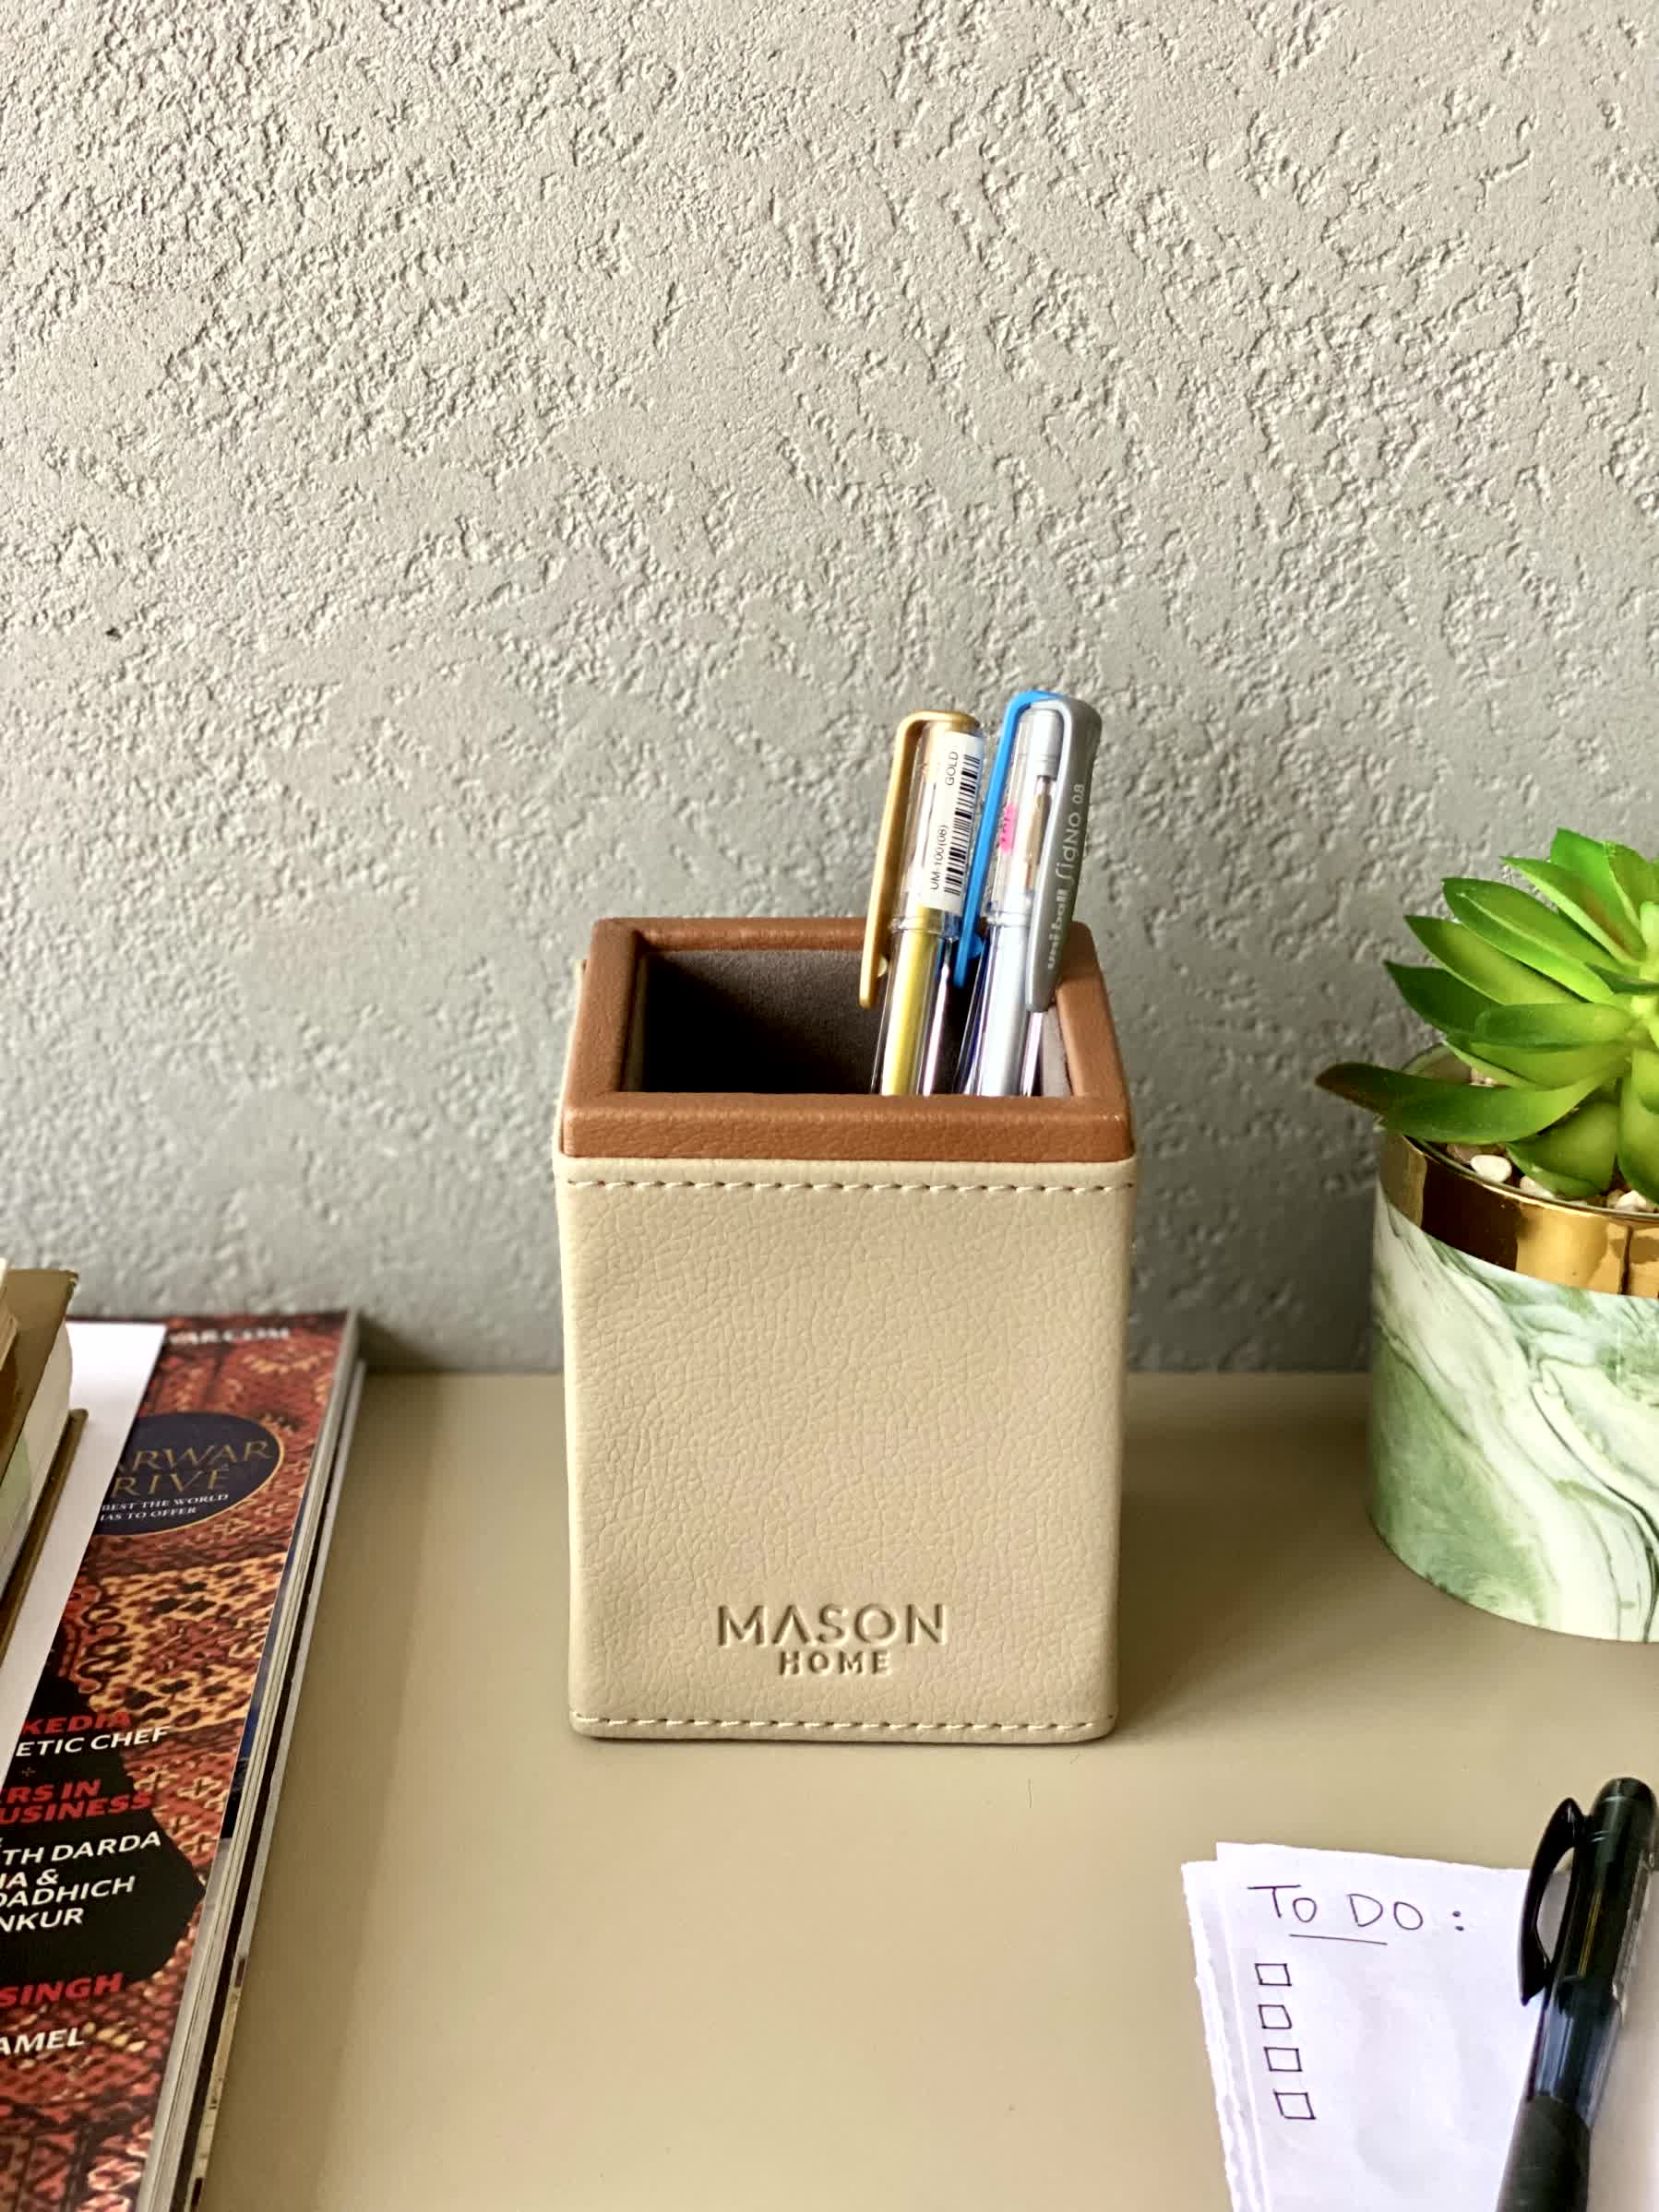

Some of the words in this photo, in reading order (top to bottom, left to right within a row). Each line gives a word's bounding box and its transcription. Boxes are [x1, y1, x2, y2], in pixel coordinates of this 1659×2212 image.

[945, 751, 959, 786] GOLD
[118, 1440, 273, 1472] RWAR
[126, 1509, 147, 1520] TO
[150, 1505, 197, 1518] OFFER
[141, 1497, 171, 1510] THE
[173, 1493, 230, 1506] WORLD
[717, 1602, 949, 1647] MASON
[780, 1650, 893, 1676] HOME
[23, 1711, 132, 1735] KEDIA
[16, 1737, 85, 1757] ETIC
[90, 1725, 172, 1750] CHEF
[0, 1783, 55, 1805] RS
[60, 1778, 101, 1801] IN
[0, 1790, 155, 1825] USINESS
[2, 1846, 45, 1866] TH
[51, 1830, 161, 1861] DARDA
[36, 1868, 60, 1885] &
[0, 1972, 125, 2008] SINGH
